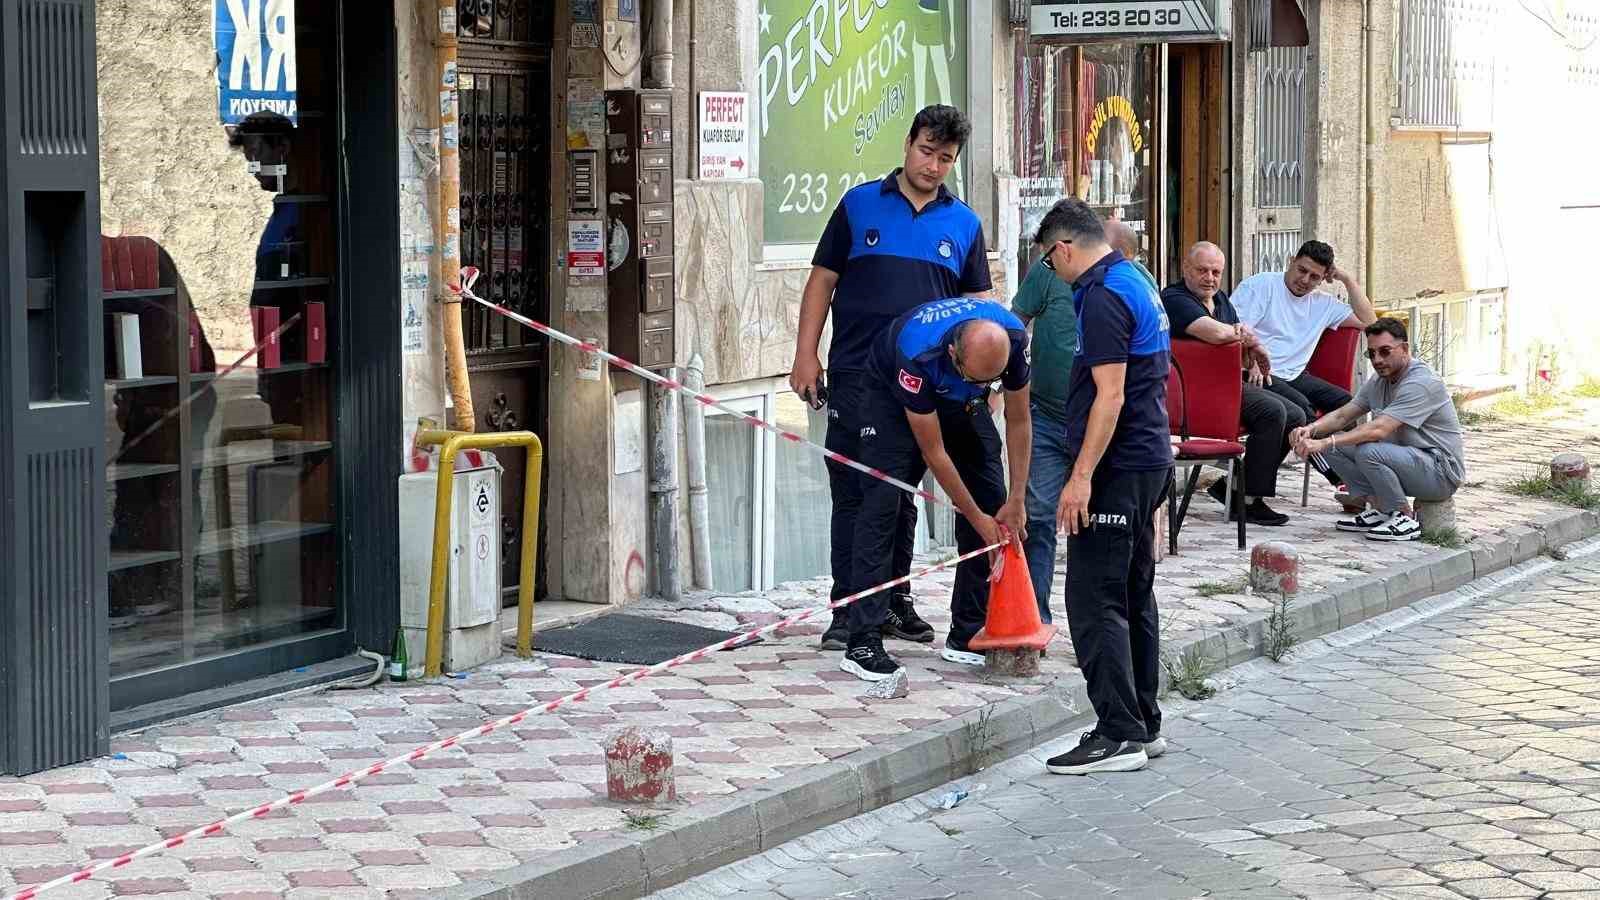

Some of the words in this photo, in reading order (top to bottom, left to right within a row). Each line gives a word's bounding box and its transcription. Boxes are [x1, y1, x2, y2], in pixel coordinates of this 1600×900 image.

[1050, 12, 1077, 27] Tel:
[1082, 11, 1120, 27] 233
[1125, 10, 1150, 26] 20
[1155, 9, 1181, 25] 30
[823, 20, 907, 131] KUAFÖR
[705, 96, 744, 123] PERFECT
[854, 73, 912, 156] Sevilay
[703, 126, 723, 143] KUAFÖR
[779, 172, 828, 214] 233
